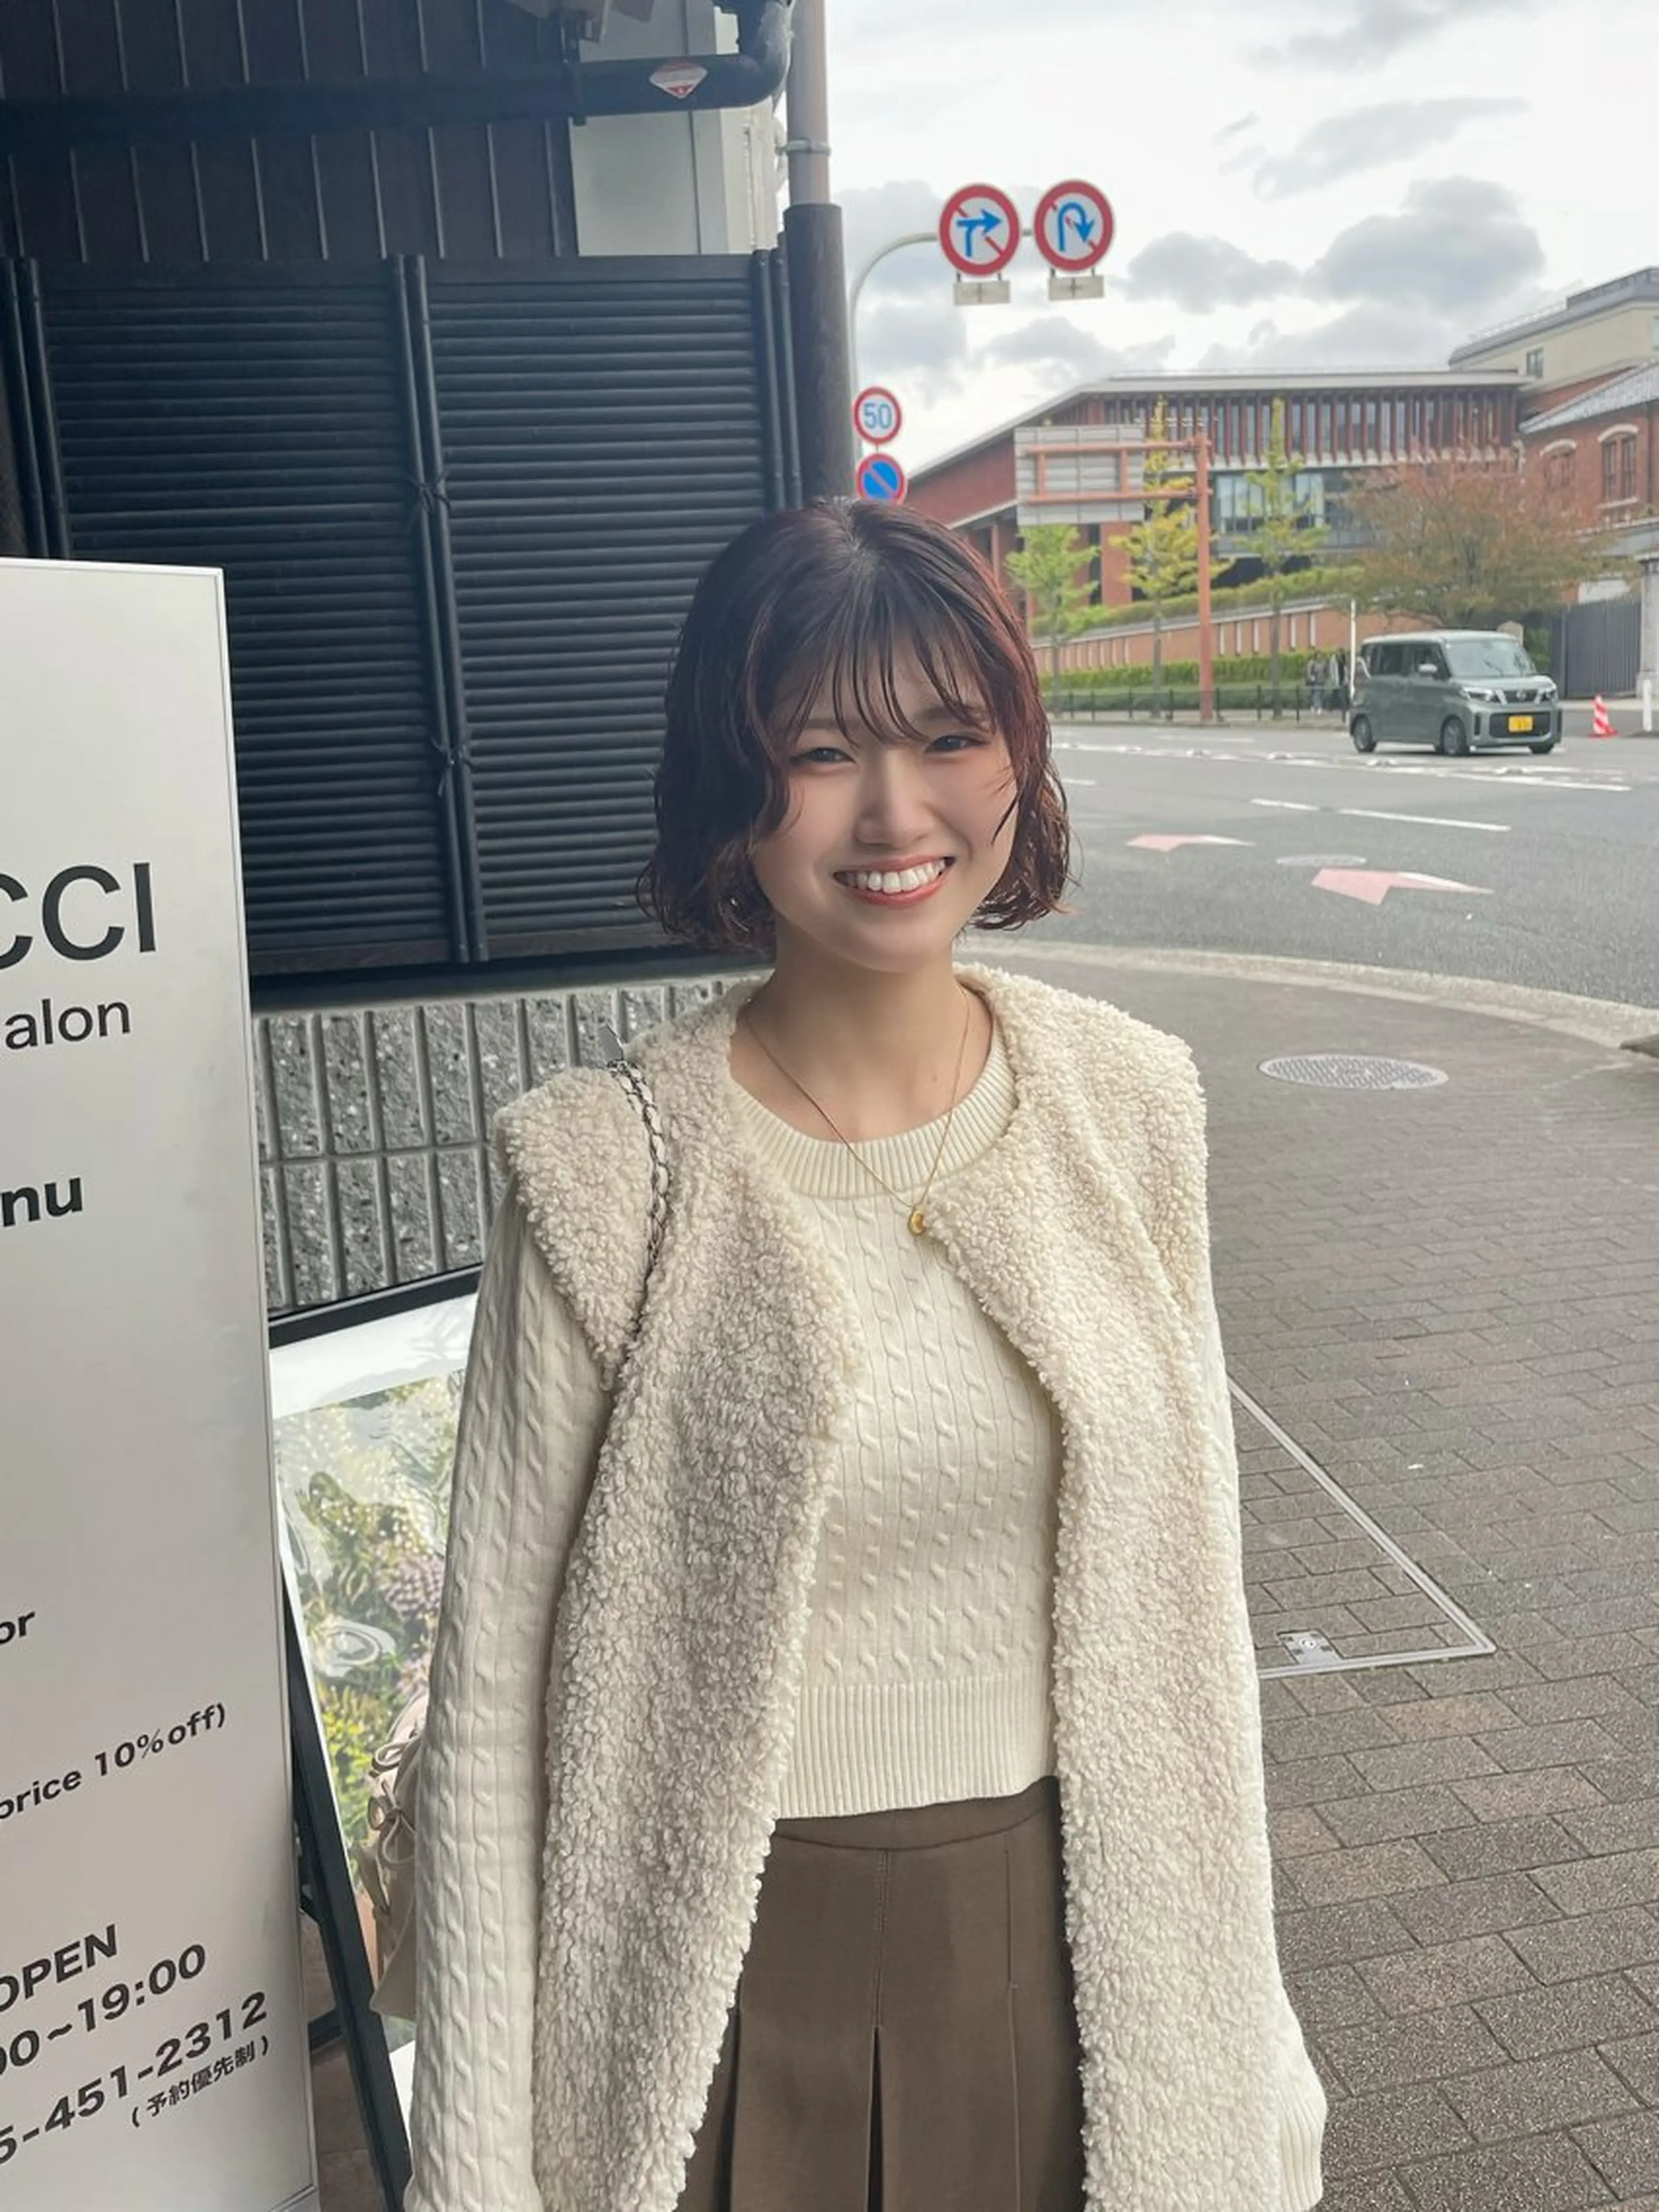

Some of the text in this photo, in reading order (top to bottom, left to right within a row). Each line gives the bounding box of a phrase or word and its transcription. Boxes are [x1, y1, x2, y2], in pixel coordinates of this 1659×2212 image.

[864, 402, 893, 429] 50
[5, 998, 131, 1050] alon
[1, 1177, 83, 1227] nu
[0, 1944, 206, 2074] 0~19:00
